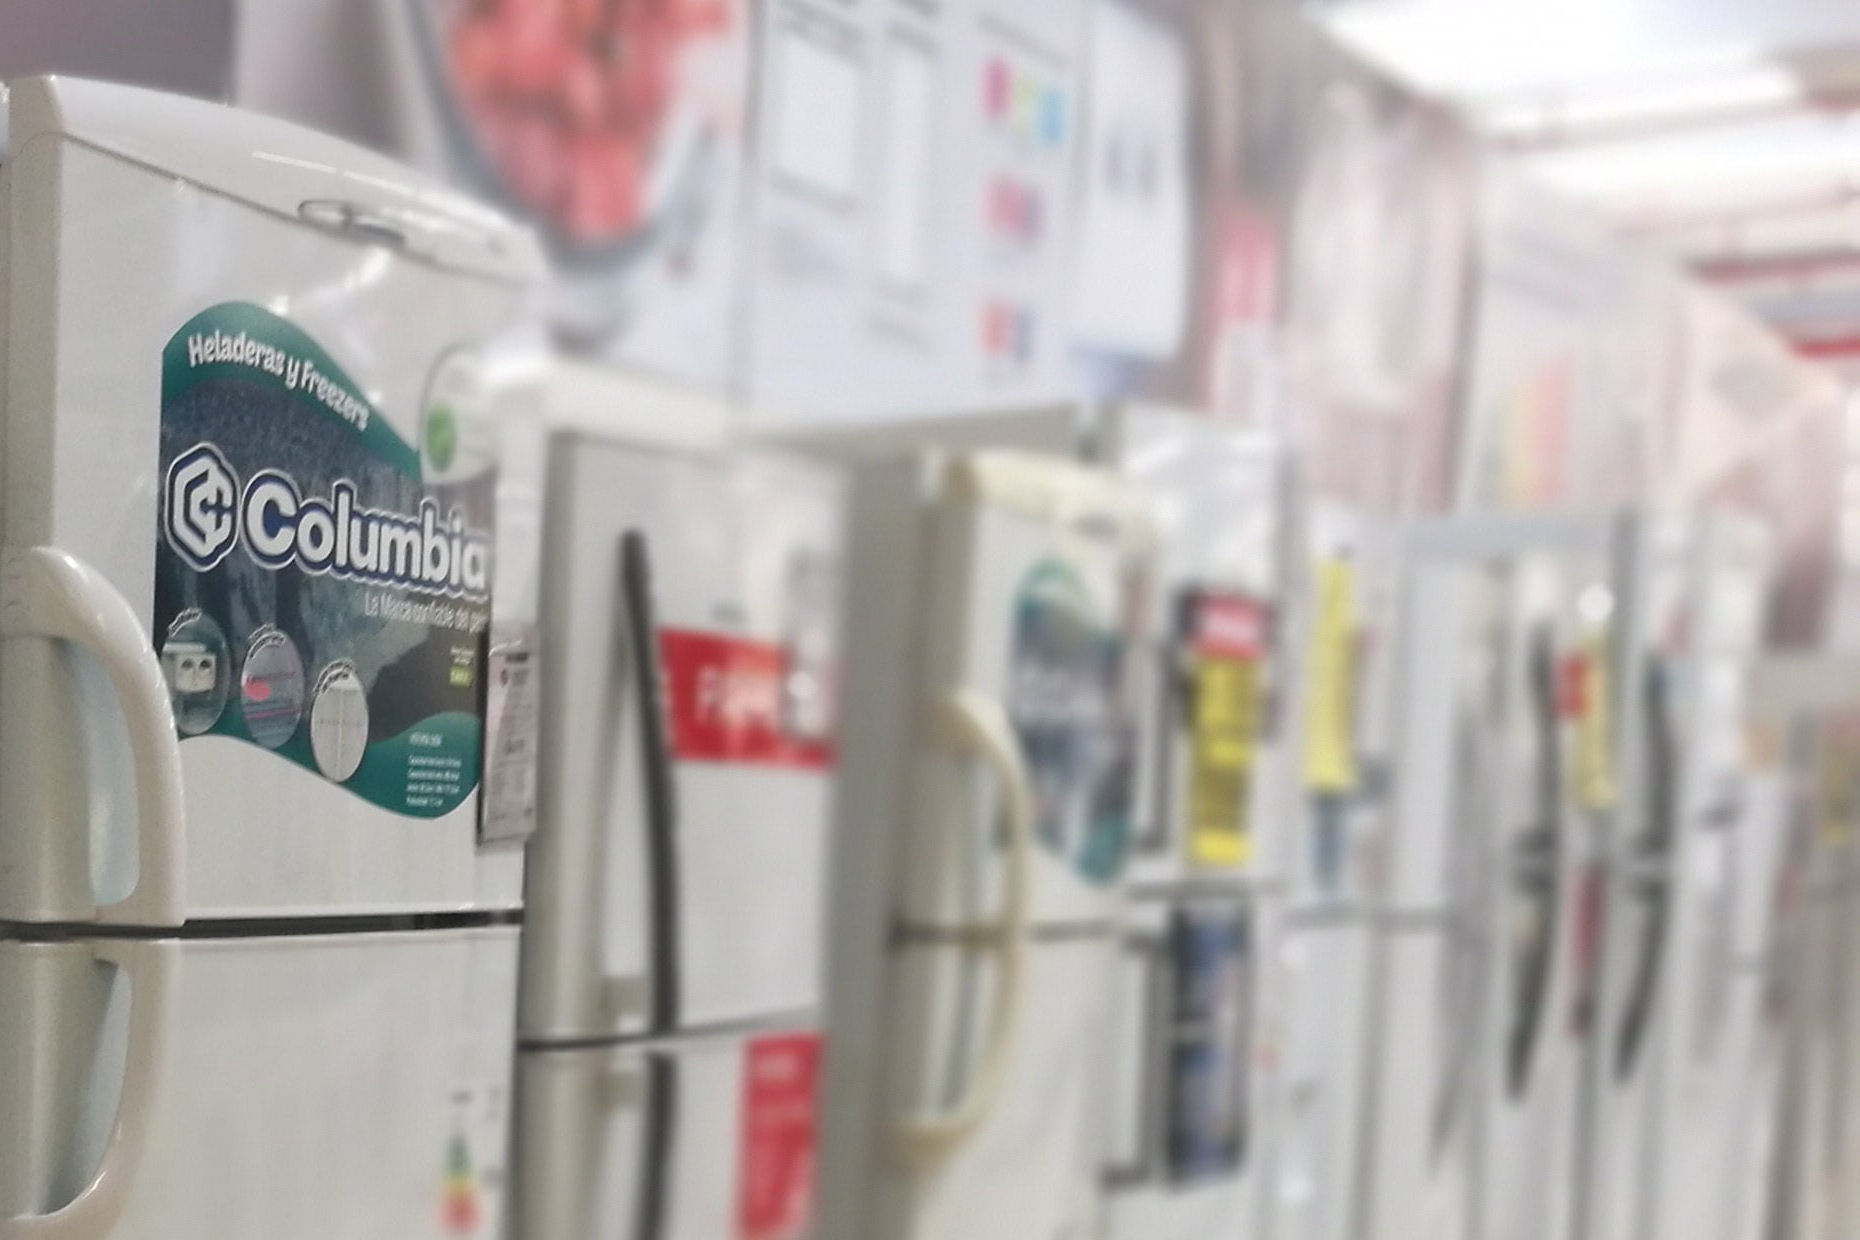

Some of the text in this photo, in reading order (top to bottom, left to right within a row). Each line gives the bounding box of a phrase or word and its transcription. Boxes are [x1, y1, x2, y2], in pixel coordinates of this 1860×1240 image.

[188, 332, 369, 431] Heladeras y Freezers
[244, 483, 487, 587] Columbia
